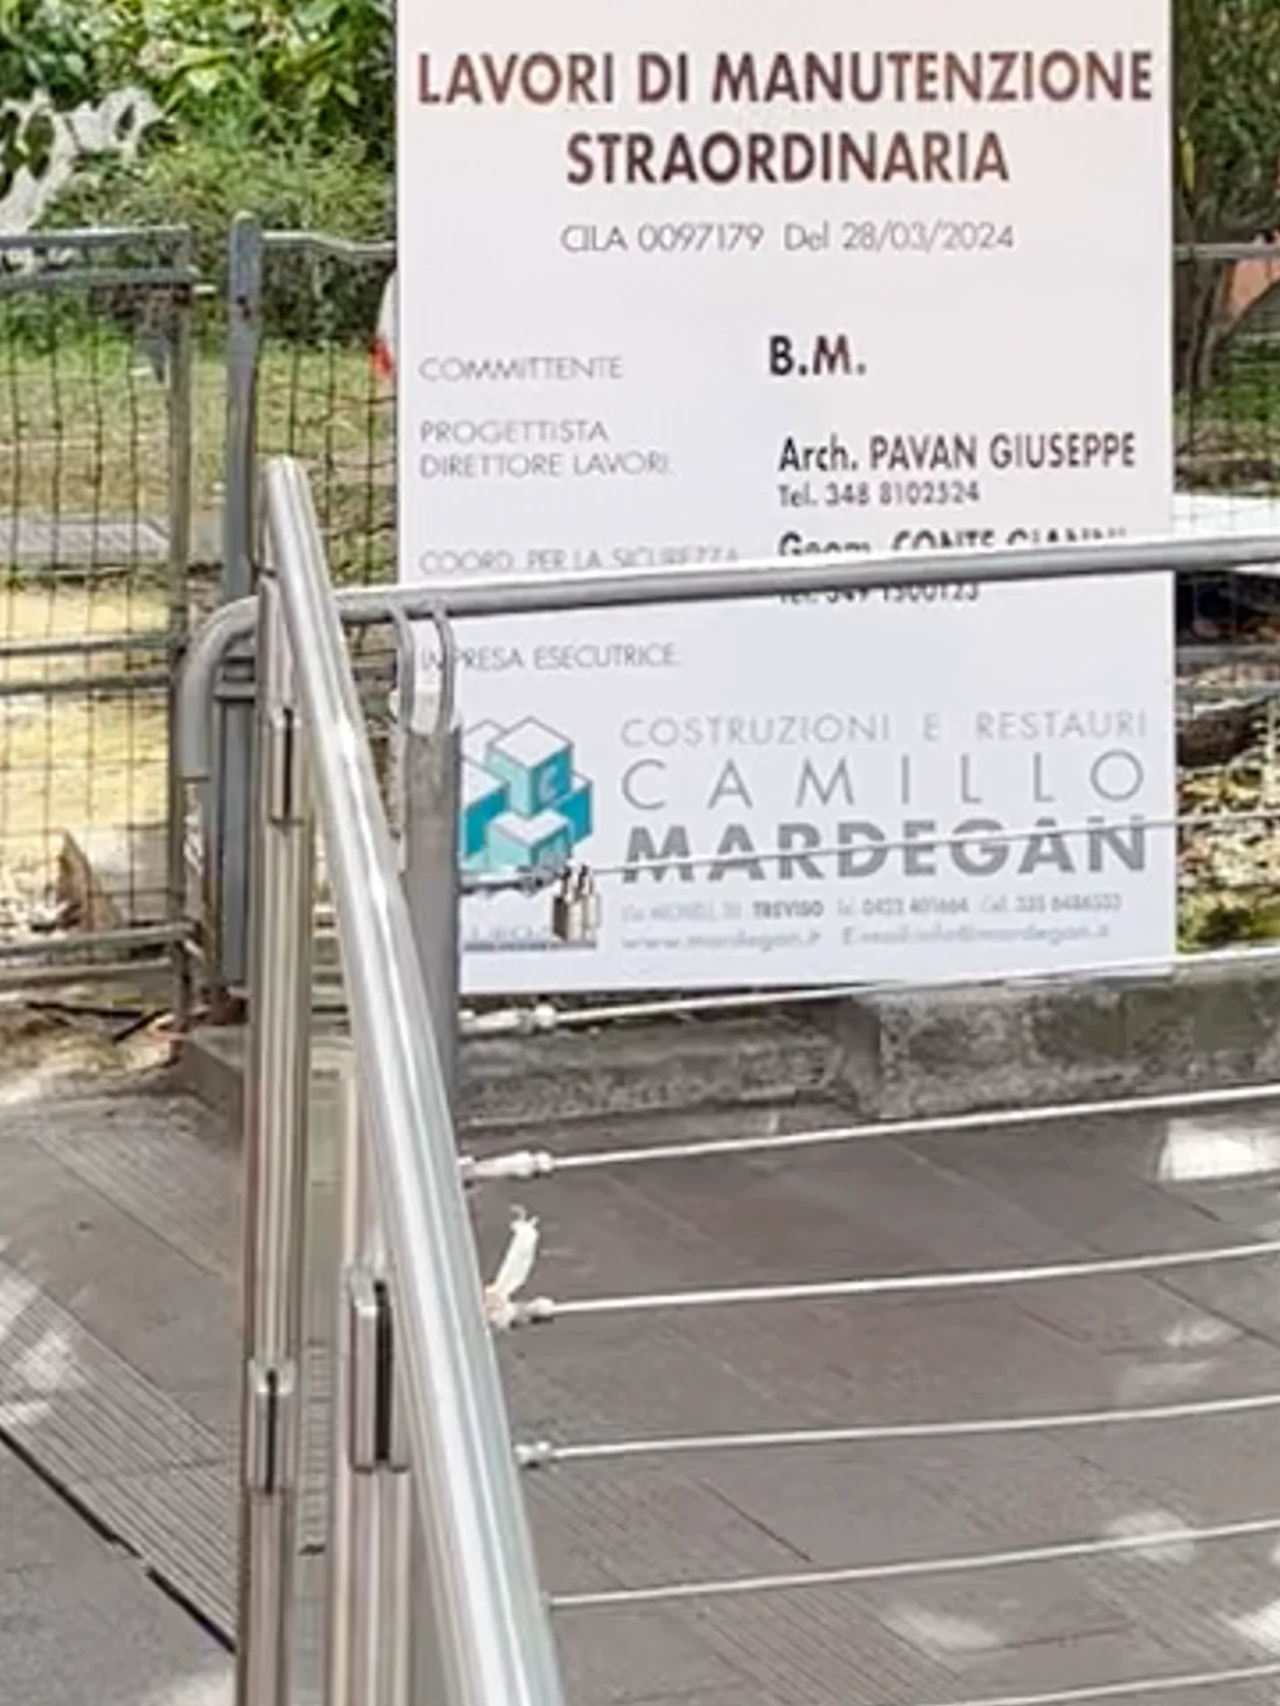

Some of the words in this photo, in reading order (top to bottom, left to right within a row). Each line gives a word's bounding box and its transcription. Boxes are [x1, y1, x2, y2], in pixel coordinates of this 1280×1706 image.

[418, 51, 614, 105] LAVORI
[638, 51, 688, 104] DI
[711, 49, 1153, 104] MANUTENZIONE
[566, 130, 1010, 185] STRAORDINARIA
[560, 223, 628, 253] CILA
[637, 223, 765, 253] 0097179
[783, 220, 830, 252] Del
[841, 221, 1015, 253] 28/03/2024
[418, 355, 623, 382] COMMITTENTE
[768, 335, 866, 377] B.M.
[420, 419, 610, 445] PROGETTISTA
[420, 452, 563, 480] DIRETTORE
[778, 434, 859, 472] Arch.
[869, 434, 978, 470] PAVAN
[989, 432, 1136, 469] GIUSEPPE
[778, 482, 818, 507] Tel.
[825, 482, 870, 506] 348
[527, 549, 568, 570] PER
[574, 549, 603, 570] LA
[533, 641, 679, 671] ESECUTRICE
[620, 713, 889, 749] COSTRUZIONI
[923, 712, 940, 742] E
[976, 709, 1147, 740] RESTAURI
[621, 748, 1145, 811] CAMILLO
[622, 815, 1146, 883] MARDEGAN
